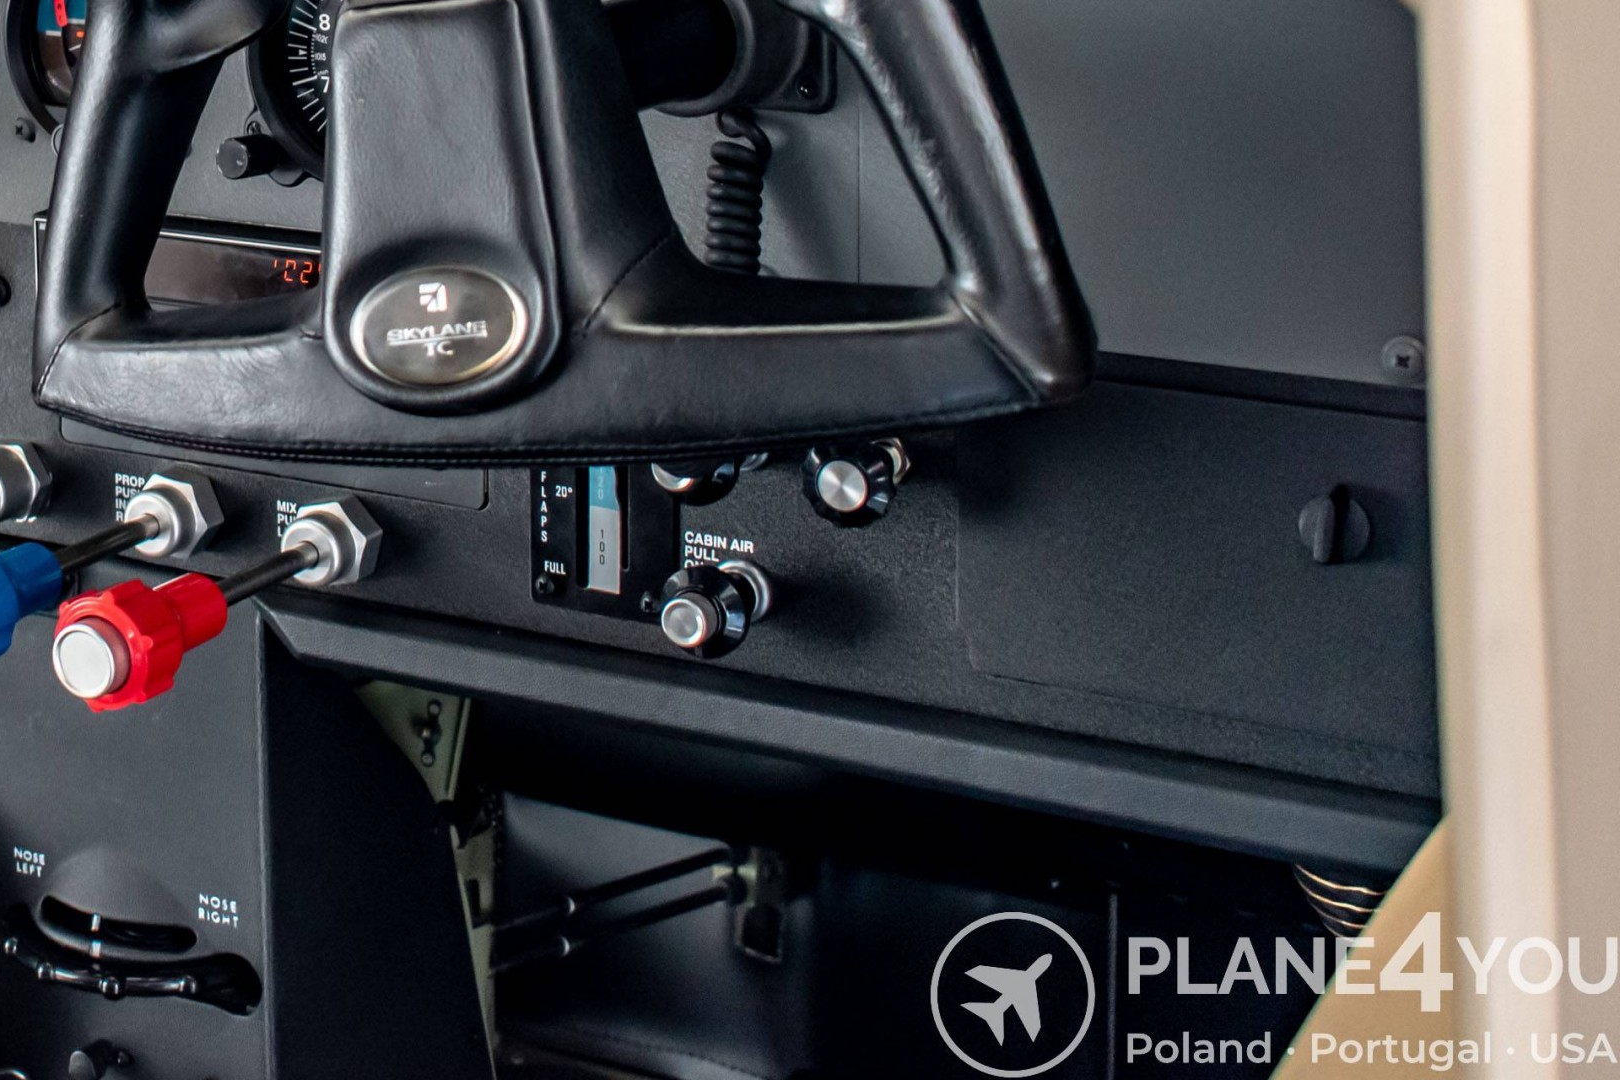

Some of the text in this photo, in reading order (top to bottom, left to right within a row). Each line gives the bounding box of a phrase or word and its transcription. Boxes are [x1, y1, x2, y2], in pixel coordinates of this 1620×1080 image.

[319, 13, 331, 31] 8
[386, 320, 487, 341] SKYLANE
[424, 340, 454, 357] TC
[115, 472, 145, 488] PROP
[555, 485, 573, 498] 20°
[277, 499, 297, 515] MIX
[540, 471, 548, 543] FLAPS
[684, 531, 754, 554] CABIN AIR
[684, 544, 720, 562] PULL
[544, 560, 566, 575] FULL
[14, 846, 45, 866] NOSE
[16, 862, 42, 878] LEFT
[198, 893, 237, 914] NOSE
[198, 908, 239, 928] RIGHT
